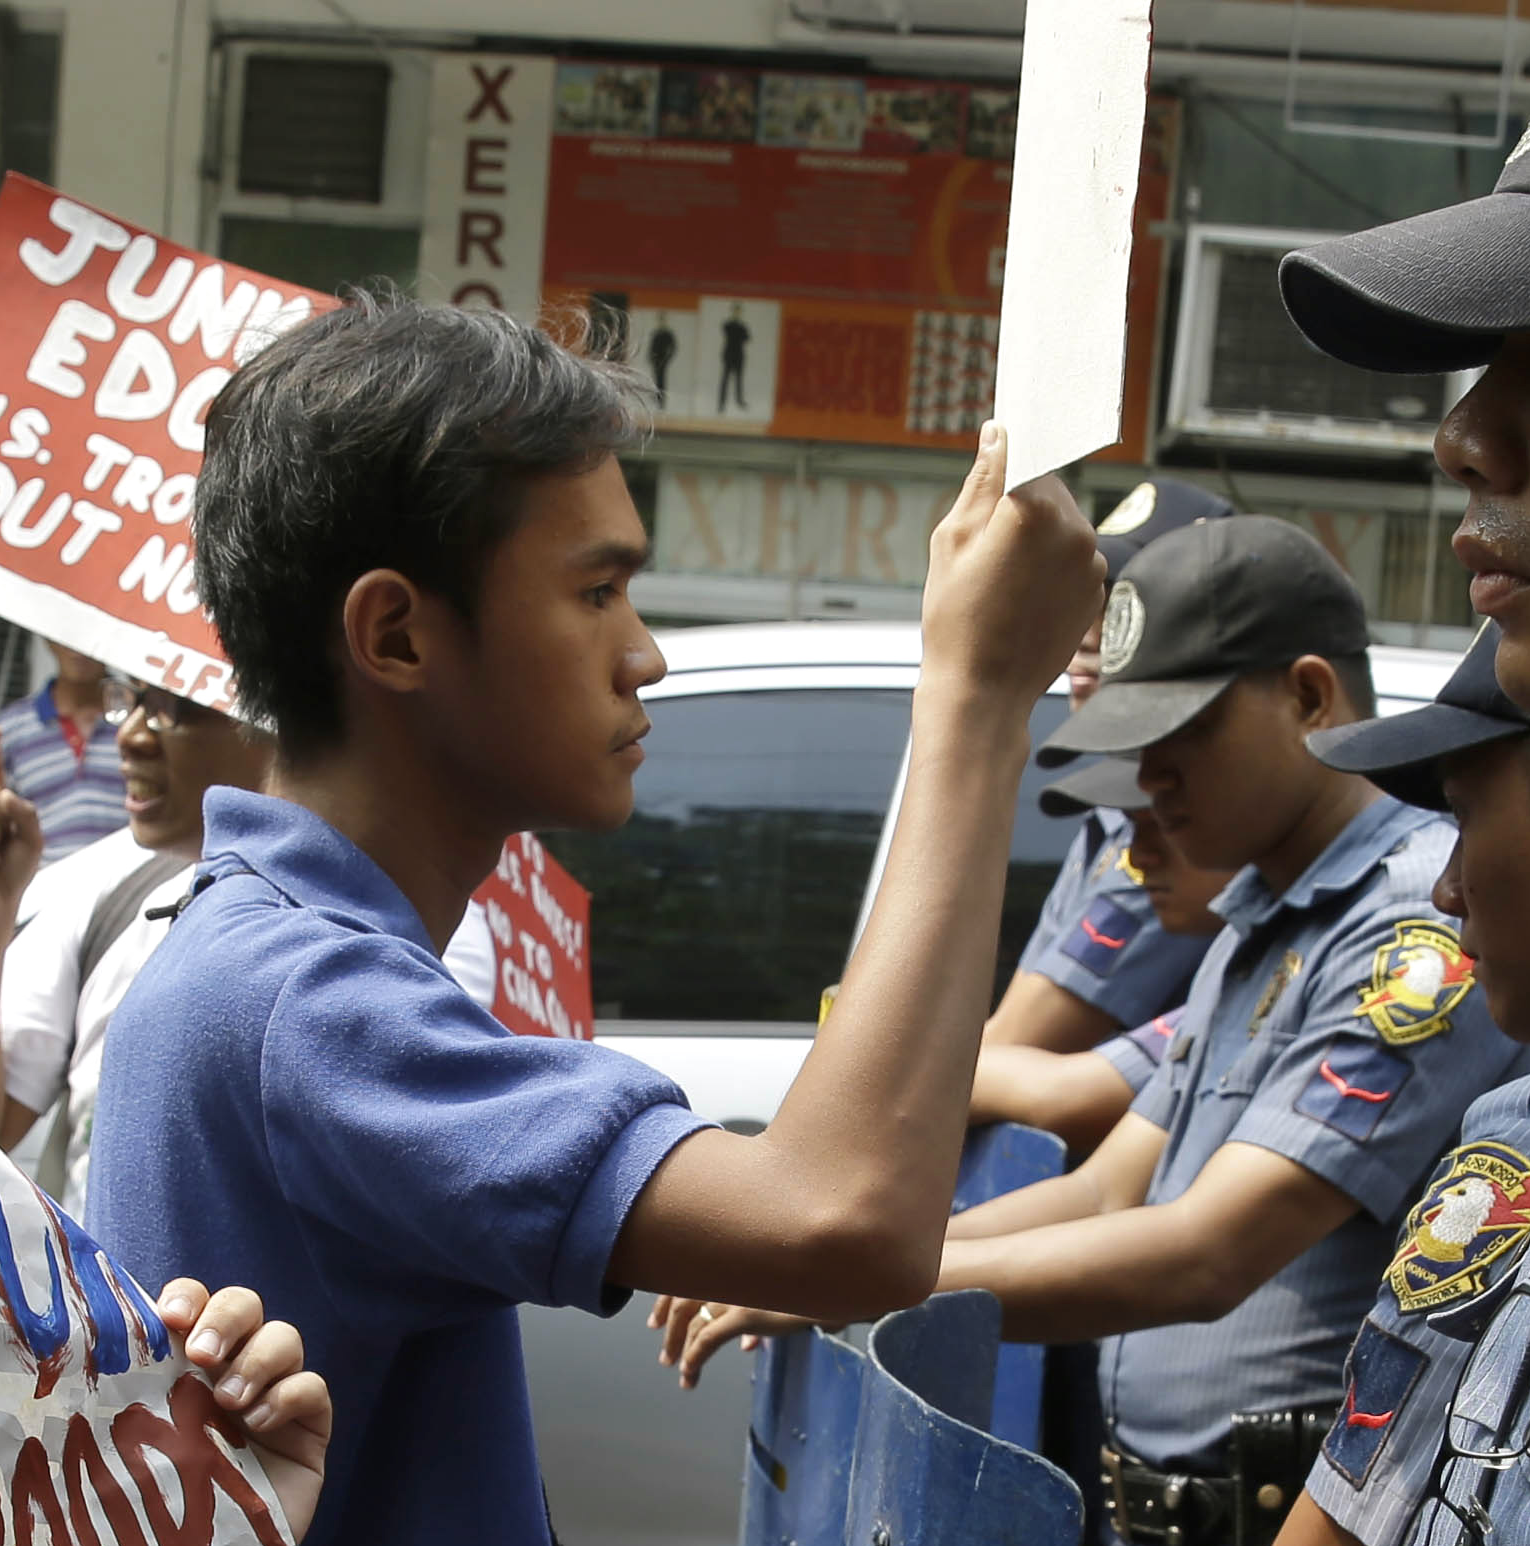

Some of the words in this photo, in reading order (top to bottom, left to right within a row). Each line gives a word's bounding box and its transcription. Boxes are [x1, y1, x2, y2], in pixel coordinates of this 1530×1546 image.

[18, 197, 312, 369] JUNK
[25, 299, 235, 452] EDC
[82, 433, 198, 526] TRO
[118, 534, 202, 615] NO
[518, 928, 554, 982] TO
[1405, 1261, 1438, 1284] HONOR
